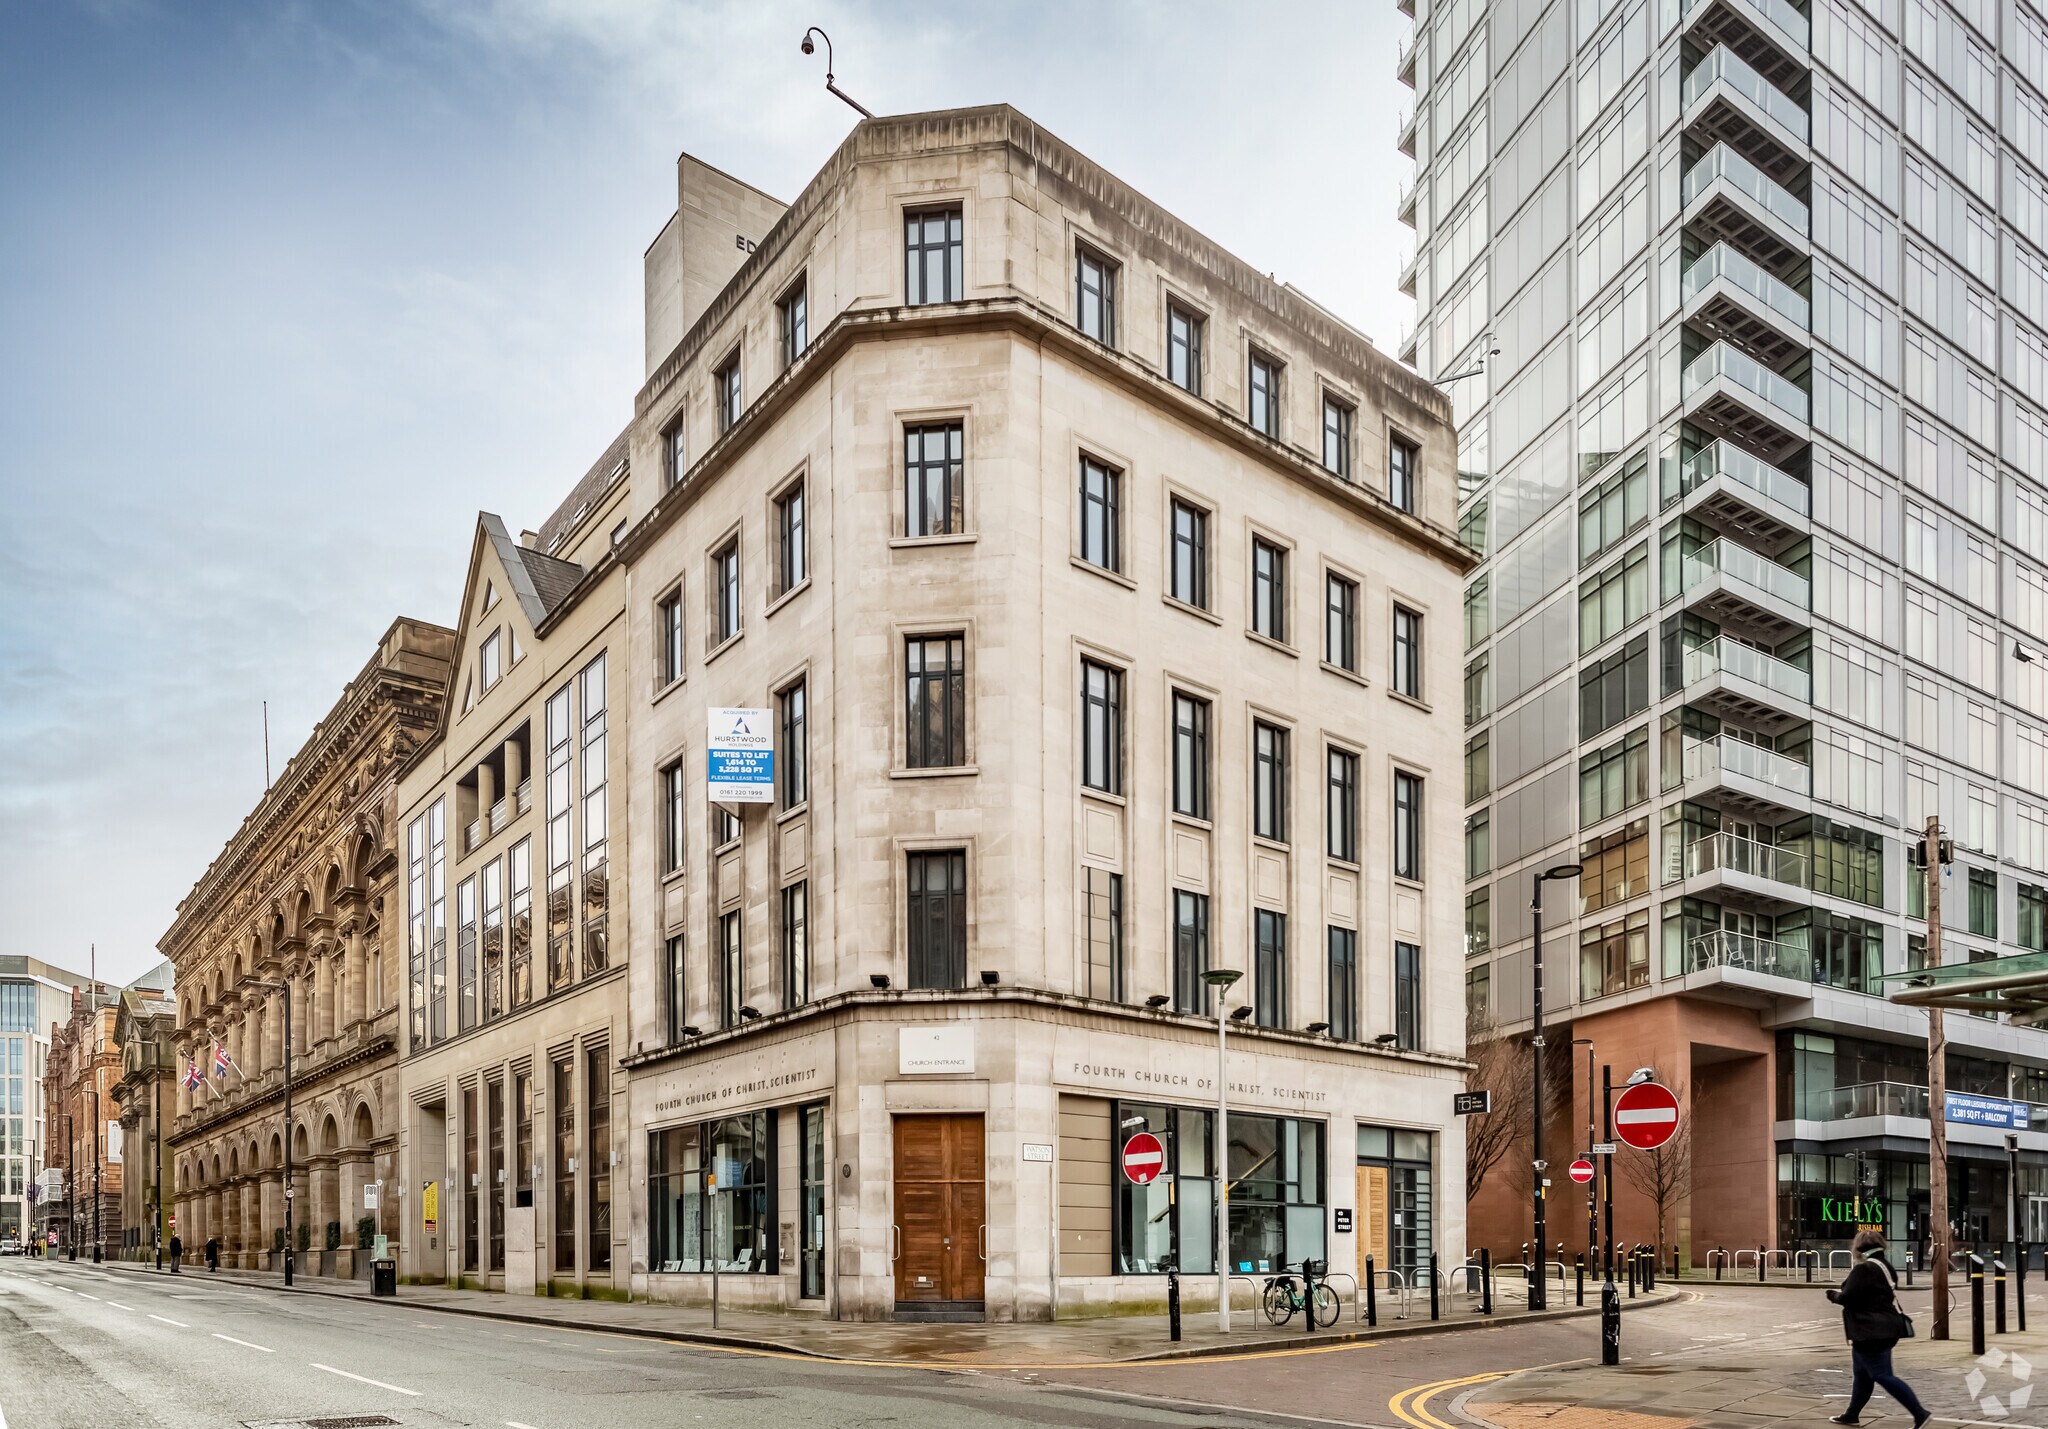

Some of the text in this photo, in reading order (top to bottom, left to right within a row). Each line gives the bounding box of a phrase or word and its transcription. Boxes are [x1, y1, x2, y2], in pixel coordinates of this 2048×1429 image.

[655, 1068, 816, 1112] FOURTH CHURCH OF CHRIST, SCIENTIST
[1074, 1063, 1326, 1102] FOURTH CHURCH OF HRIST, SCIENTIST
[1947, 1096, 2013, 1112] FIRST FLOOR LEISURE OPPORTUNITY
[1952, 1108, 1966, 1118] 2,381
[1966, 1110, 1975, 1120] SQ
[1975, 1111, 1981, 1120] FT
[1985, 1112, 2008, 1122] BALCONY
